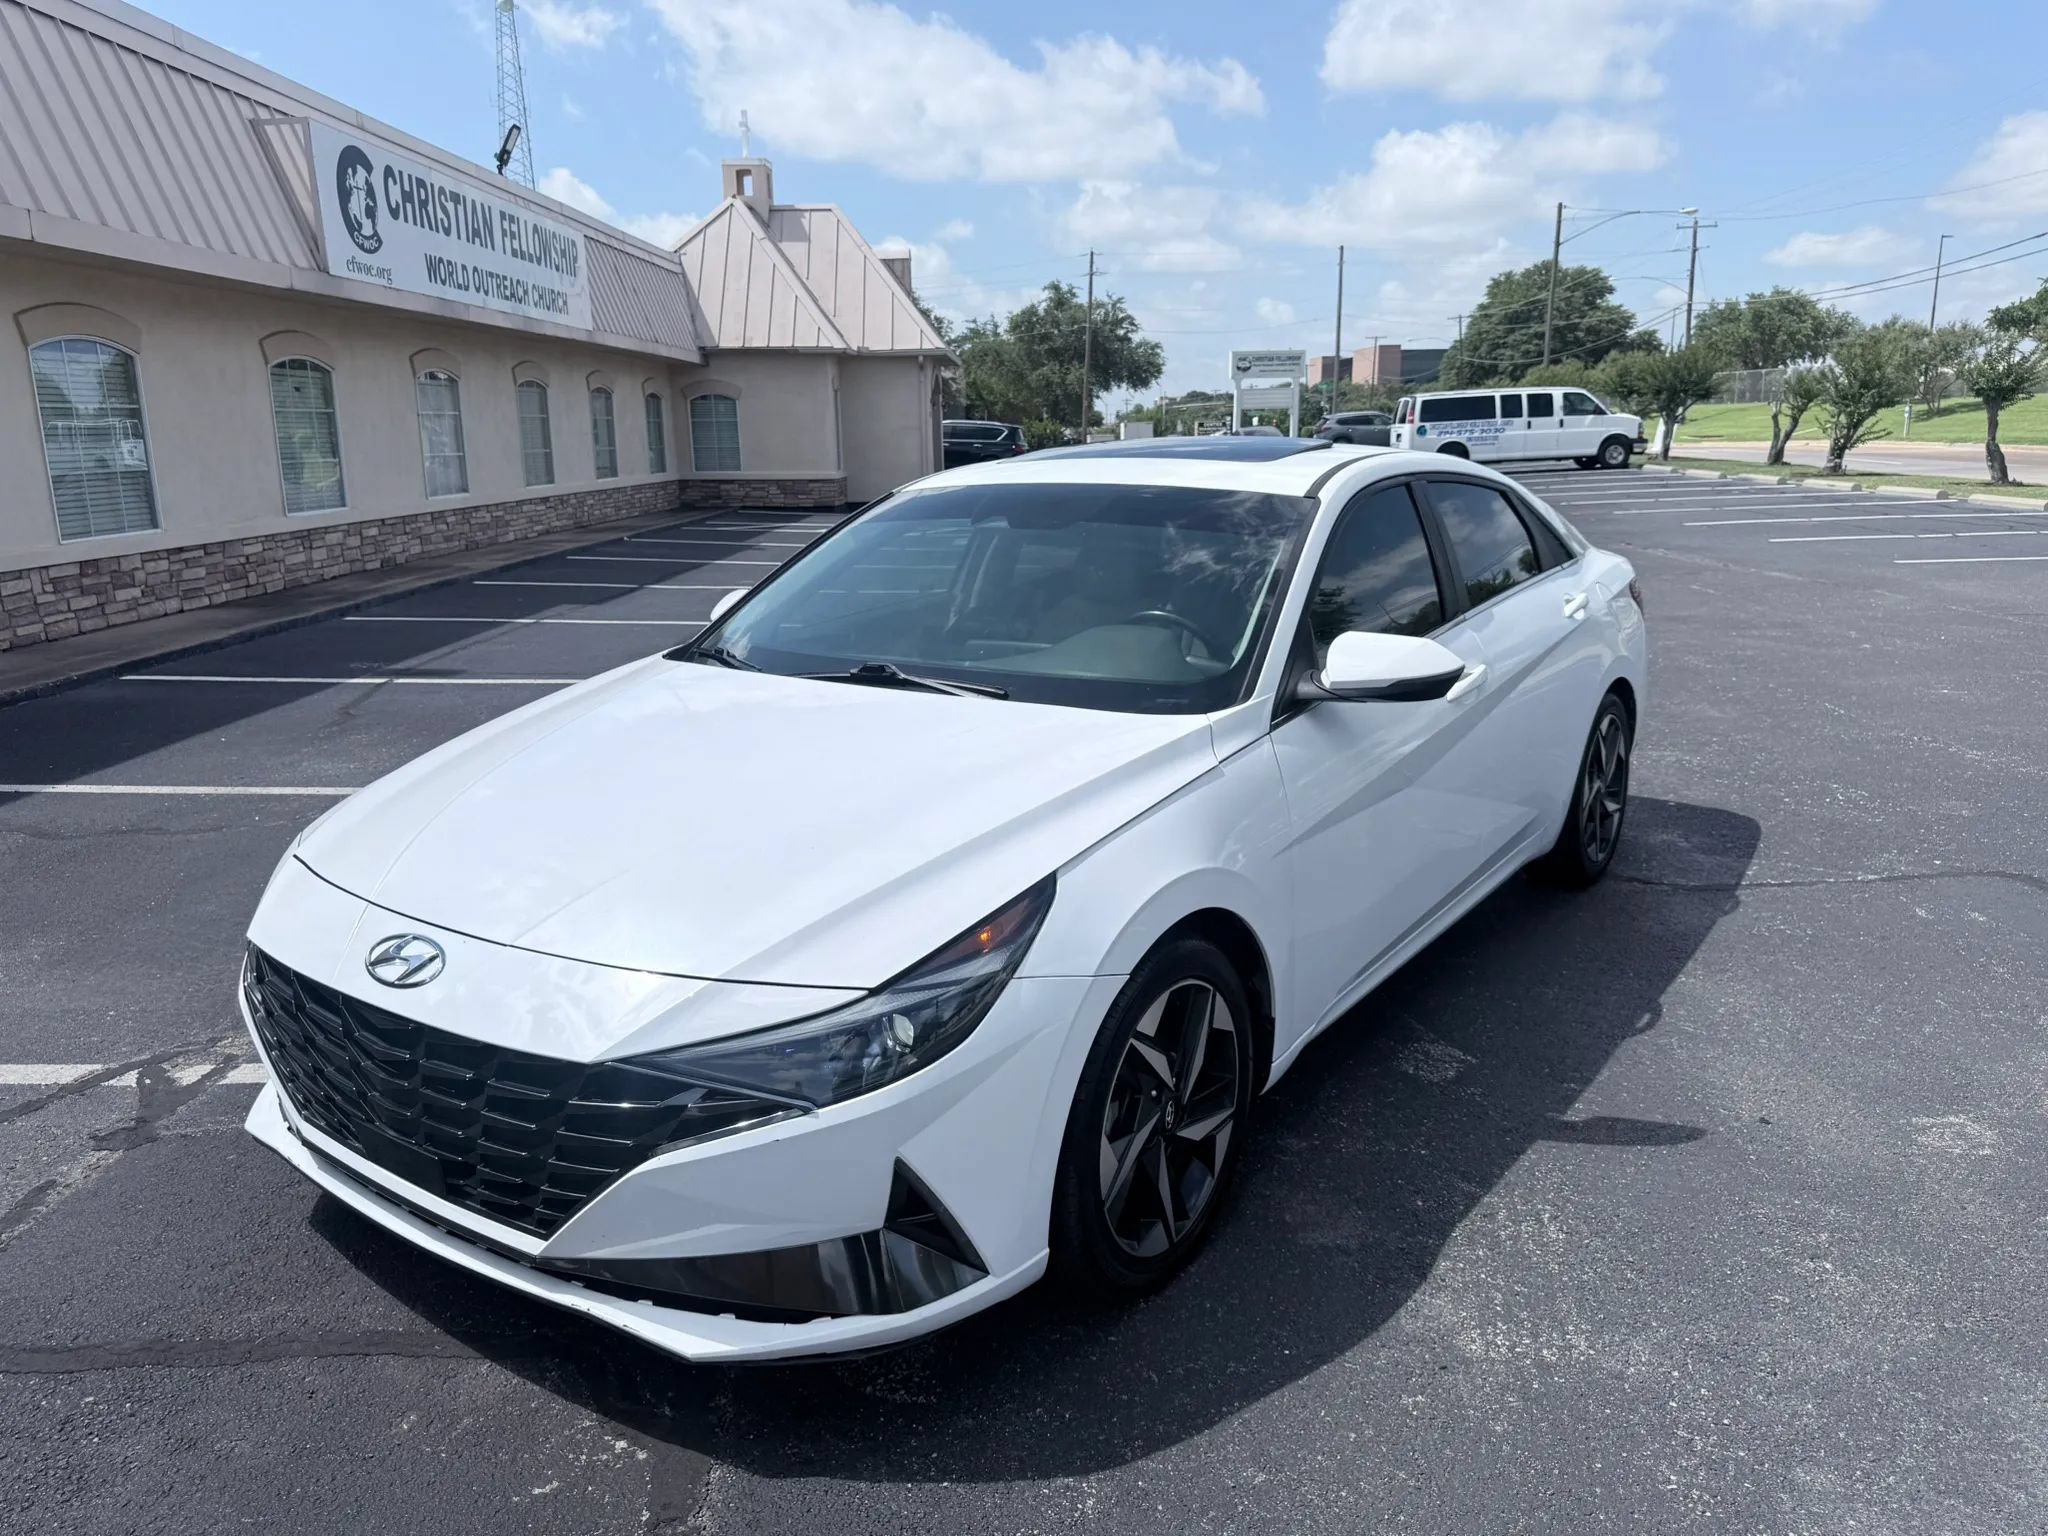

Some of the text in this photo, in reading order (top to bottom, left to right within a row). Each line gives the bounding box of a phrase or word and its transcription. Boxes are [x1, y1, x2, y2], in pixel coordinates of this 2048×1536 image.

[353, 231, 380, 250] CFWOC
[383, 164, 578, 278] CHRISTIAN FELLOWSHIP
[346, 255, 393, 285] cfwoc.org
[424, 252, 569, 316] WORLD OUTREACH CHURCH
